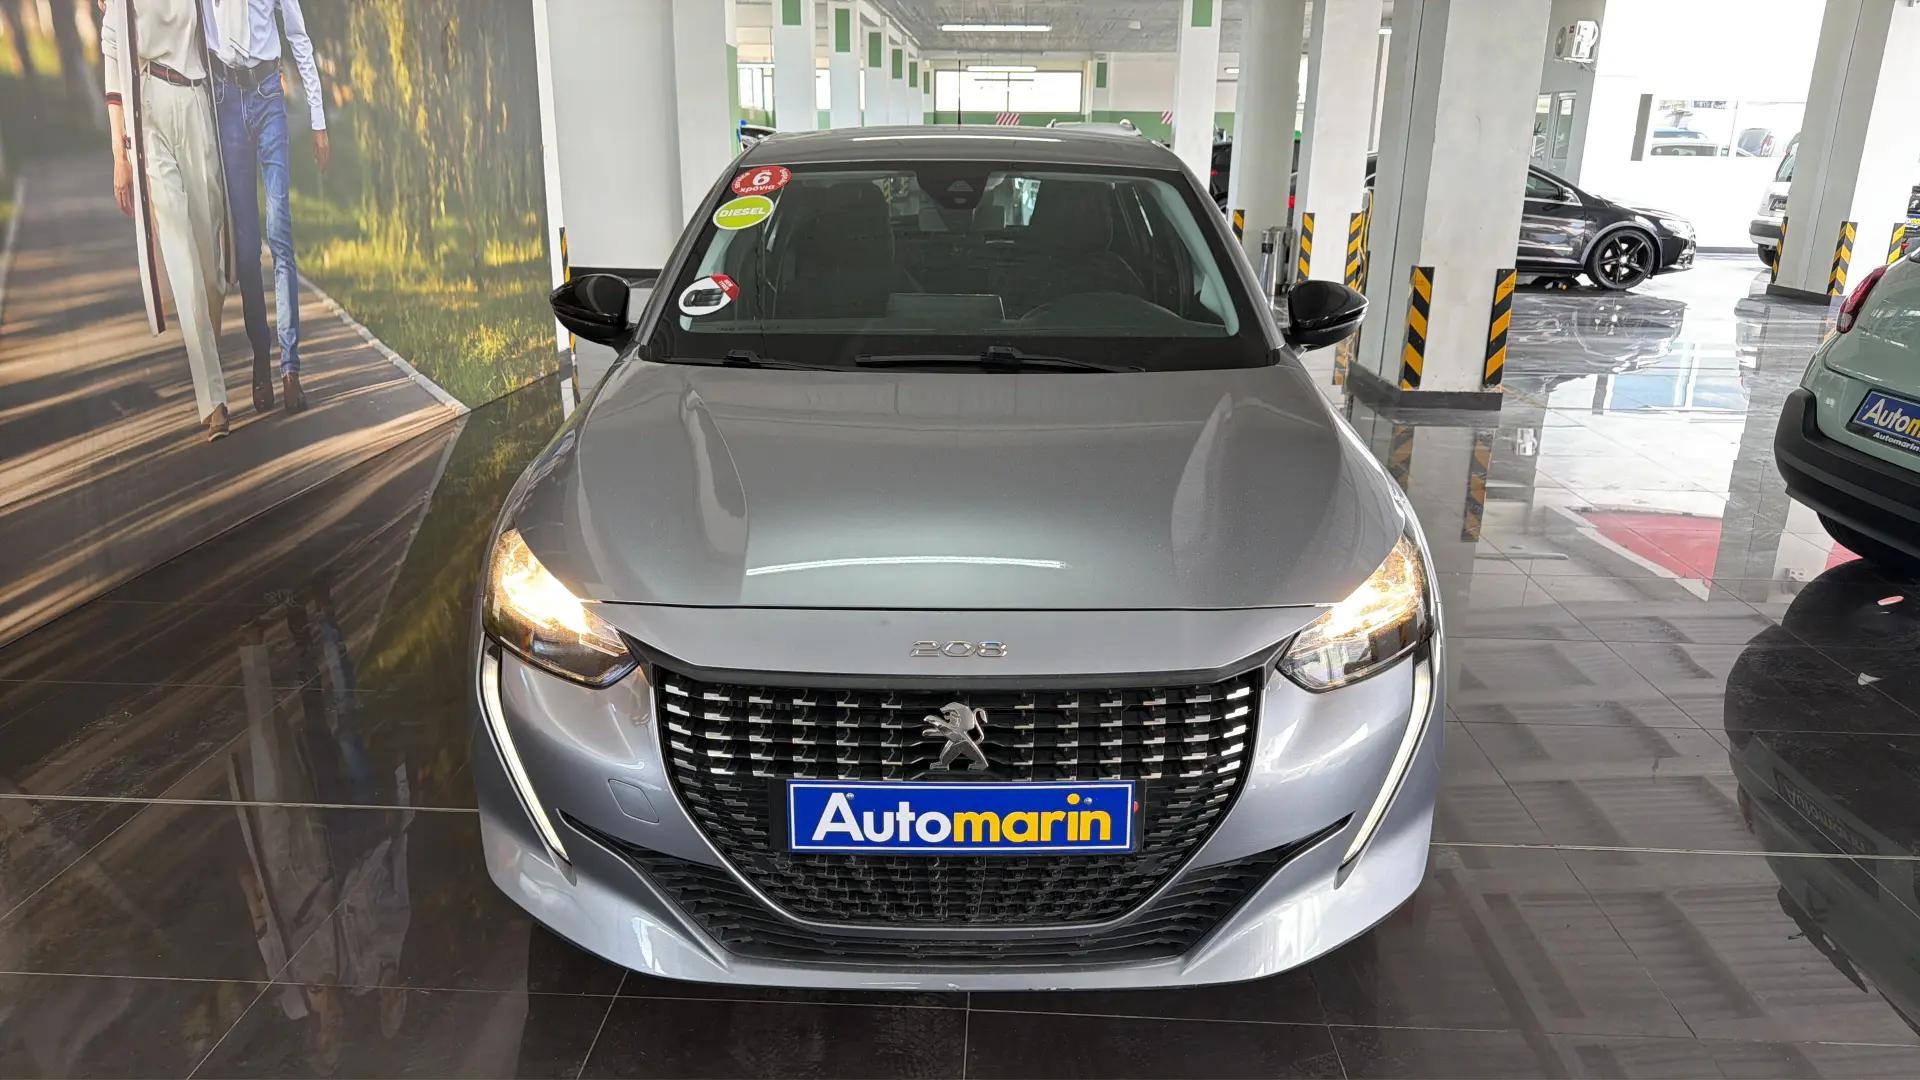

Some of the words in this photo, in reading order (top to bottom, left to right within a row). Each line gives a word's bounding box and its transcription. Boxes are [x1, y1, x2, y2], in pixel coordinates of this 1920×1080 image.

[752, 171, 772, 186] 6
[739, 184, 775, 194] χρόνια
[718, 207, 767, 218] DIESEL
[910, 640, 1008, 657] 208
[811, 791, 1112, 843] Automarin
